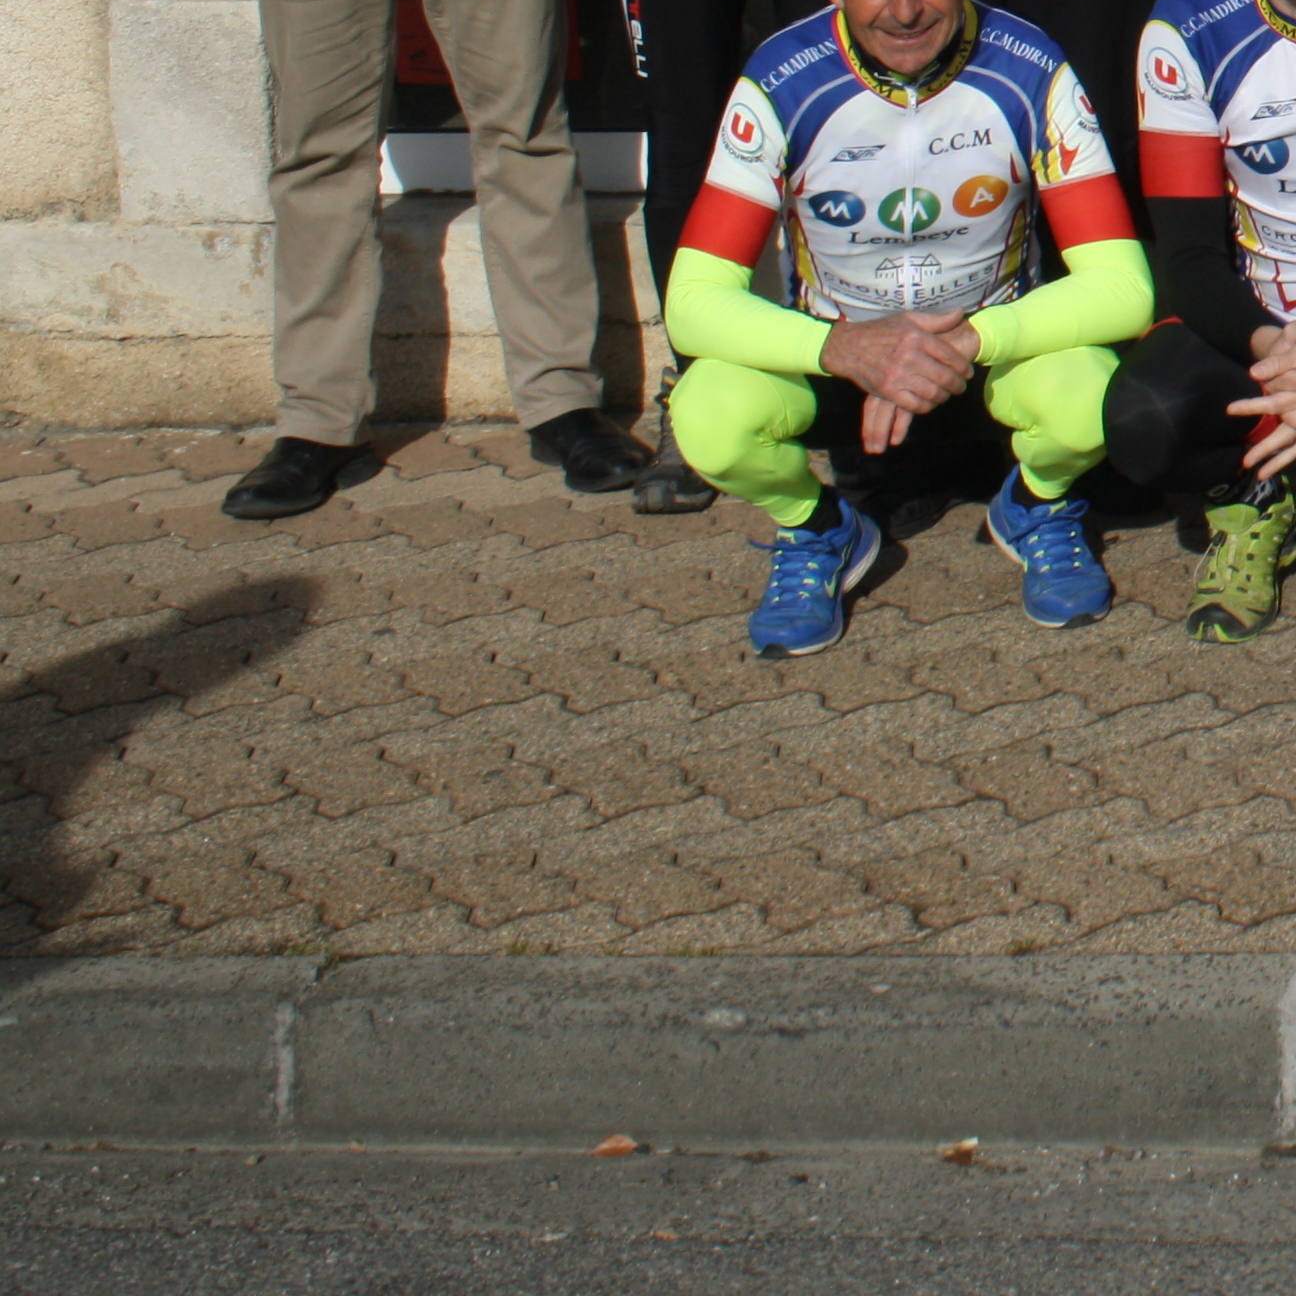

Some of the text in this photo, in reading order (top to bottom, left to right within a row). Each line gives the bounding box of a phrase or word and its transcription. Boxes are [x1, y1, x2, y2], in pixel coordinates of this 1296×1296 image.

[761, 38, 837, 93] C.C.MADIRAN
[981, 27, 1057, 72] C.C.MADIRAN
[1154, 56, 1177, 85] U
[731, 111, 754, 144] U
[929, 128, 992, 155] C.C.M
